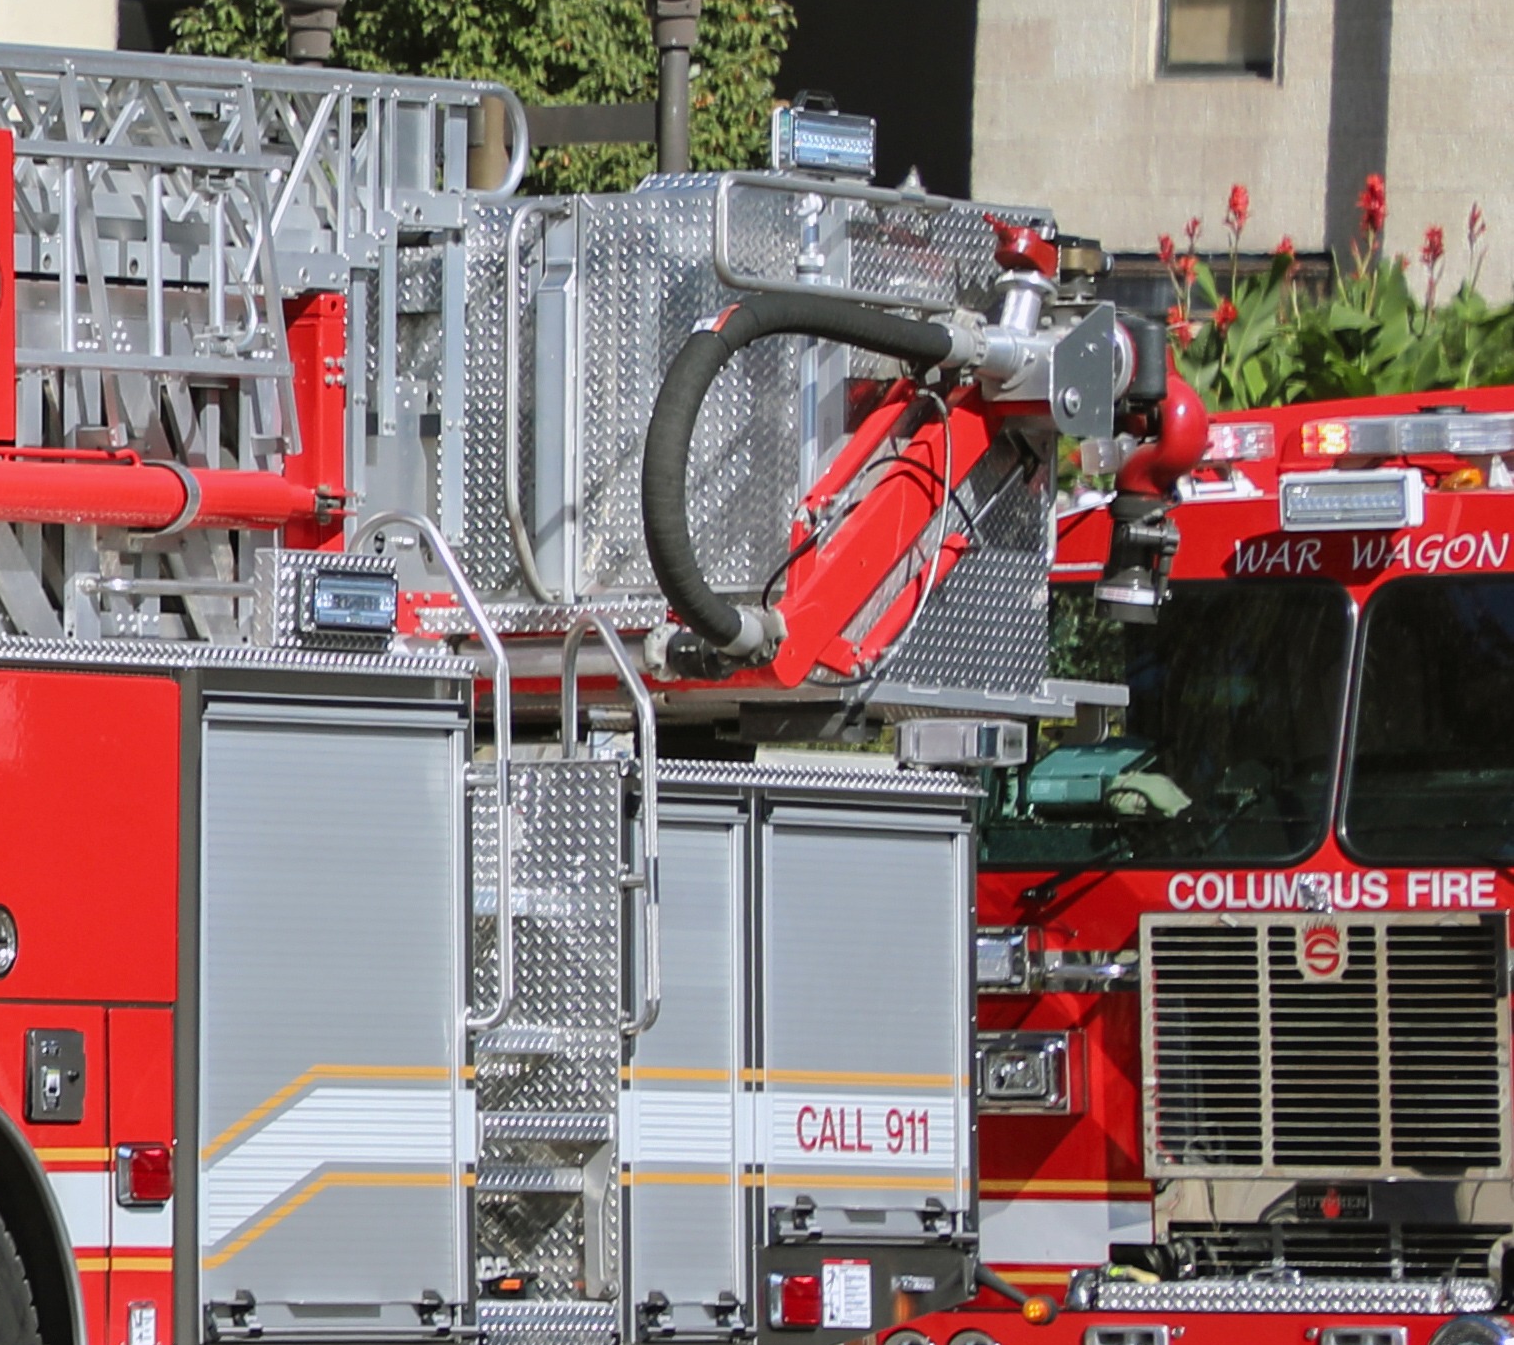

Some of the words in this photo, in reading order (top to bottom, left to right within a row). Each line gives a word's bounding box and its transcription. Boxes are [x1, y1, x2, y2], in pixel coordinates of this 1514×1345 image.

[1234, 538, 1323, 575] WAR
[1351, 530, 1511, 574] WAGON
[1407, 870, 1497, 908] FIRE
[796, 1104, 873, 1152] CALL
[885, 1107, 930, 1155] 911
